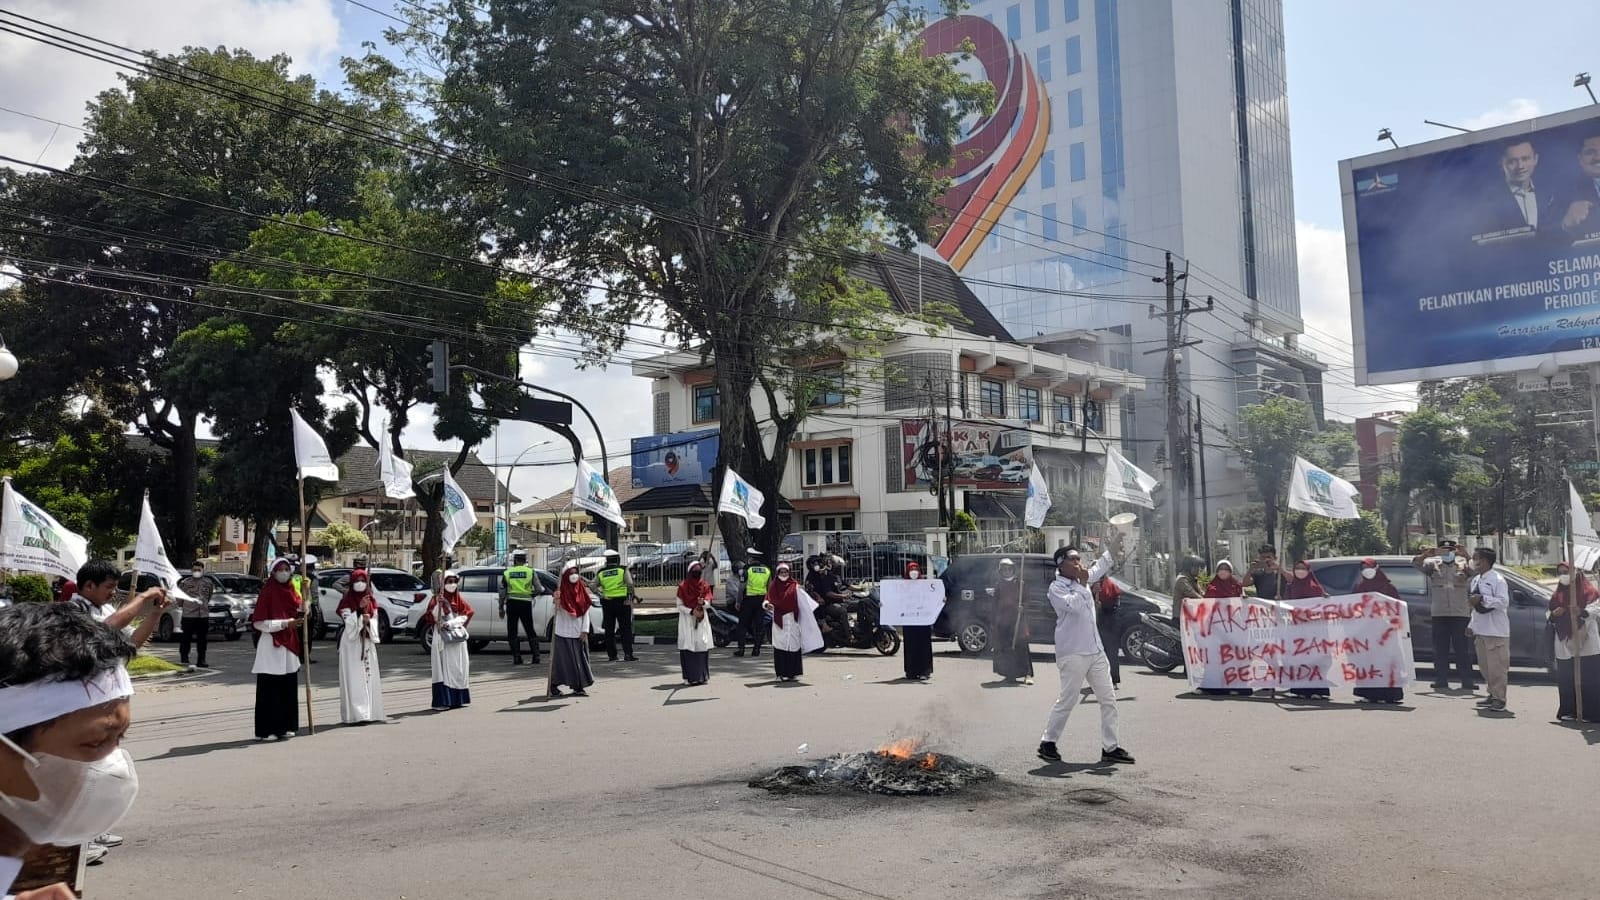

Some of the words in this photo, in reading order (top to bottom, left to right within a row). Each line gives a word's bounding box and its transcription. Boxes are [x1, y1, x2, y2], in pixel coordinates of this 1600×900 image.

[1419, 287, 1492, 311] PELANTIKAN
[1495, 279, 1560, 301] PENGURUS
[1564, 273, 1590, 291] DPD
[1545, 290, 1598, 310] PERIODE
[1182, 601, 1277, 637] MAKAN
[1188, 645, 1209, 665] INI
[1219, 640, 1285, 665] BUKAN
[1293, 637, 1369, 658] ZAMAN
[1224, 664, 1323, 685] BELANDA
